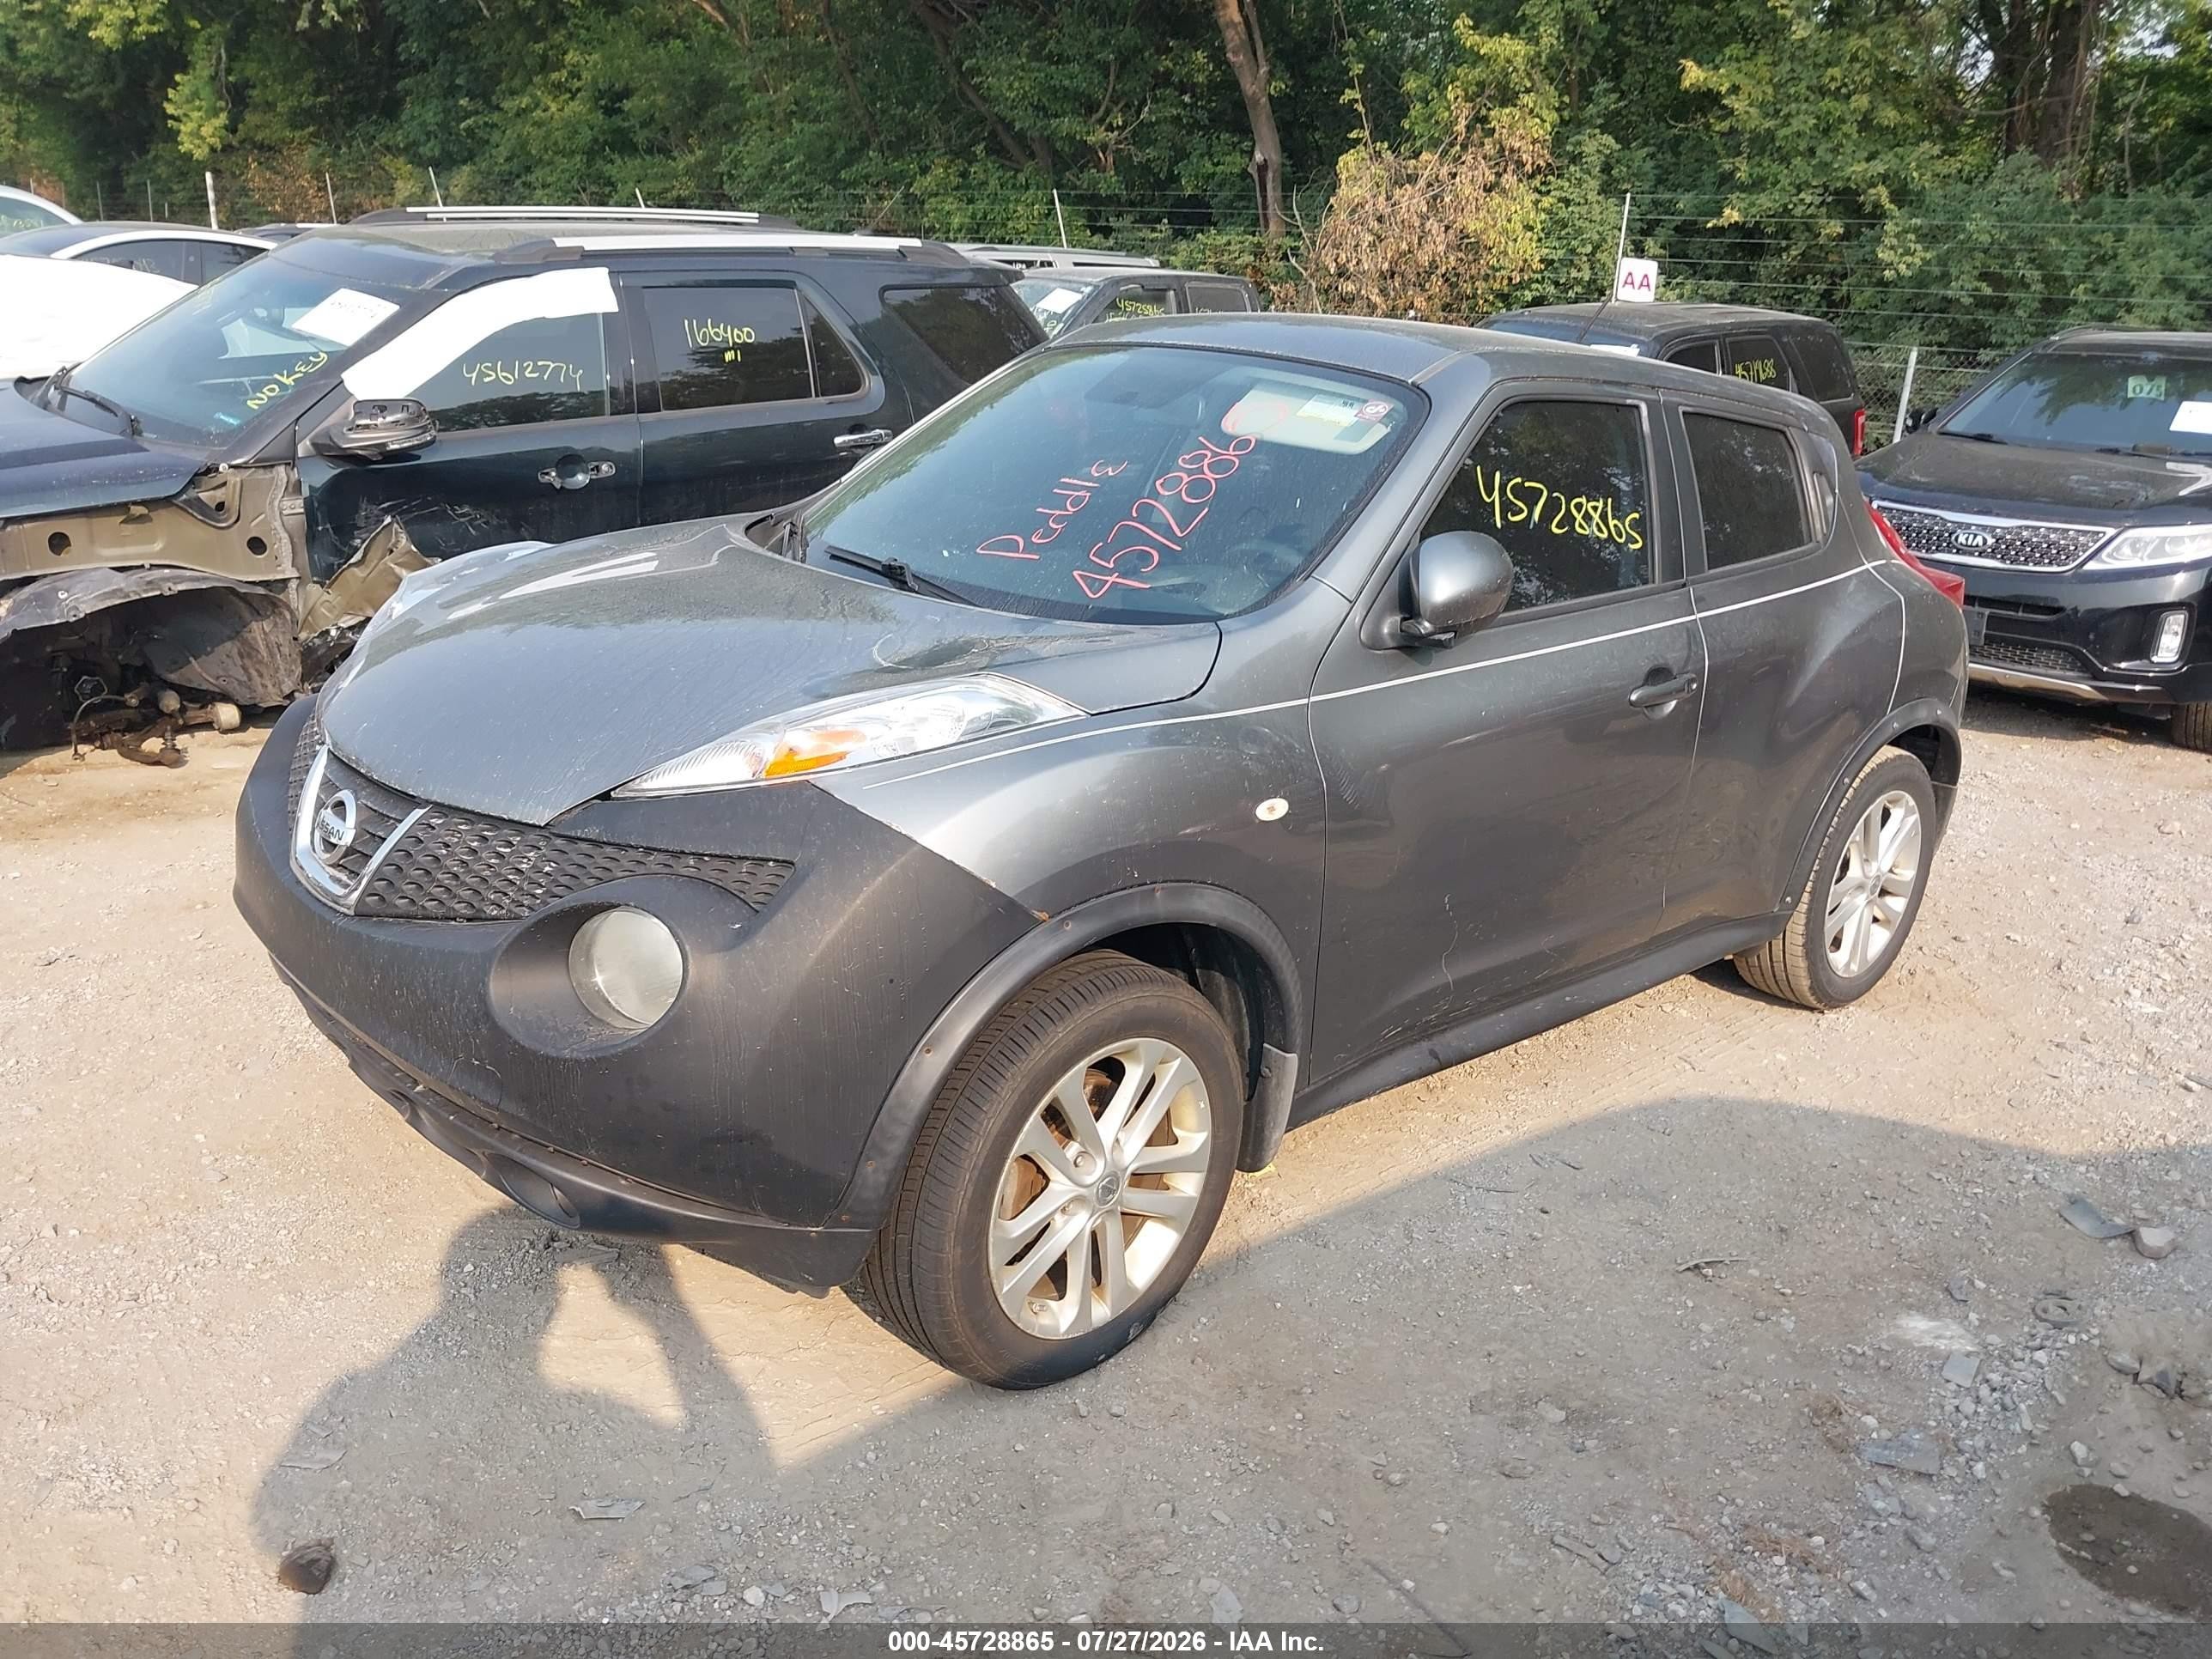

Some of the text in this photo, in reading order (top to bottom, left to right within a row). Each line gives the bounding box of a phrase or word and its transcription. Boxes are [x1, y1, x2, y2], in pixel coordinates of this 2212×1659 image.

[1622, 271, 1650, 292] AA
[684, 318, 756, 348] 166400
[463, 360, 584, 392] 45612774
[246, 384, 281, 410] NO
[1475, 465, 1644, 550] 45728865
[1958, 533, 1984, 547] KIA
